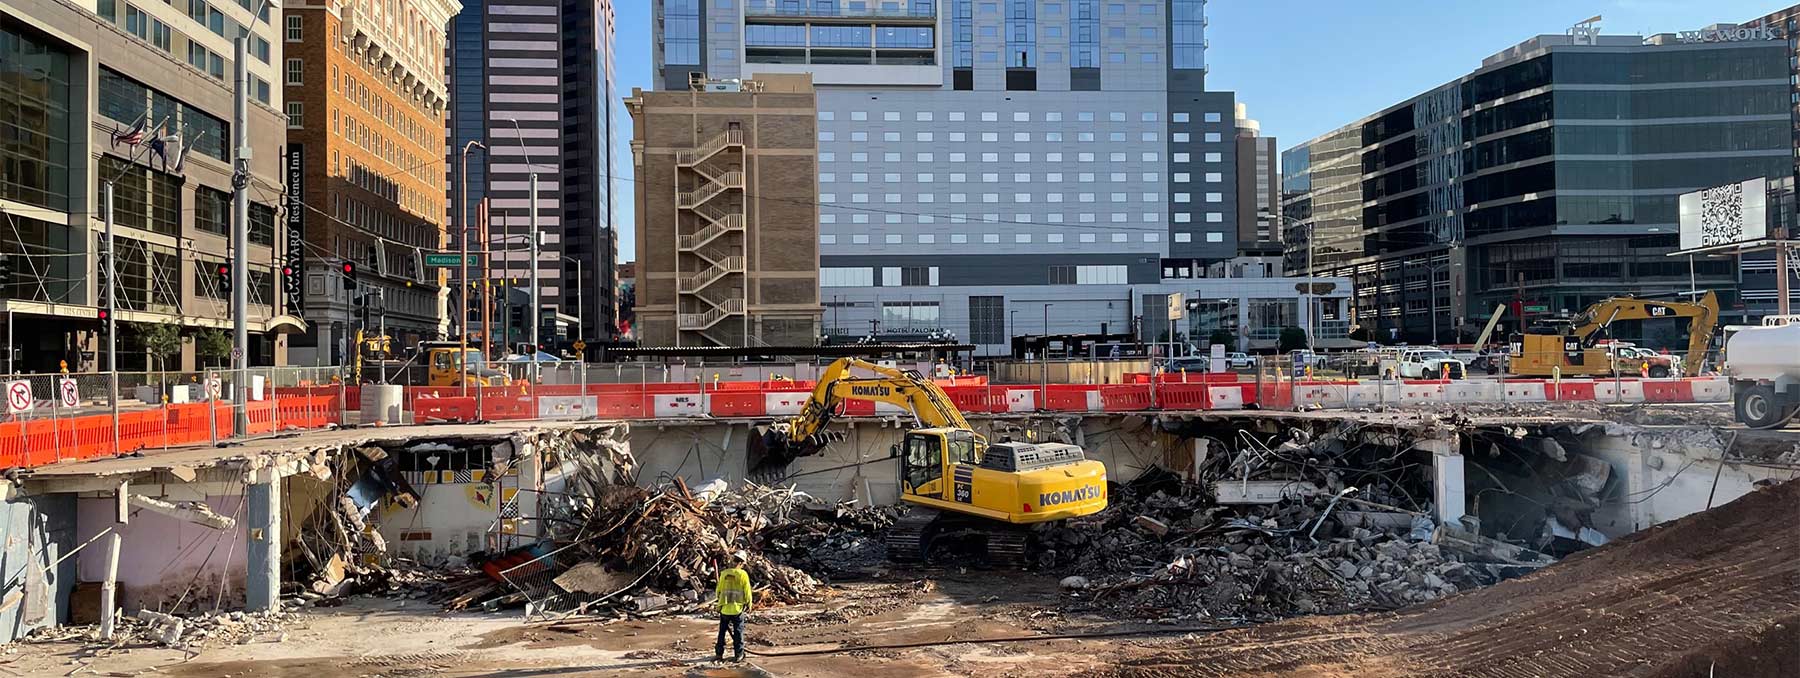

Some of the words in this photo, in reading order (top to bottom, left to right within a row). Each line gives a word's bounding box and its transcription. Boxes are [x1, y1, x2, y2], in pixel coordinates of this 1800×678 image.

[1573, 27, 1601, 45] EY
[1679, 18, 1777, 43] wework
[290, 151, 300, 170] Inn
[291, 171, 300, 223] Residence
[431, 256, 461, 264] Madison
[1652, 306, 1666, 316] CAT
[1565, 342, 1578, 351] CAT
[852, 384, 890, 396] KOMATSU
[956, 489, 970, 498] 360
[1039, 484, 1100, 507] KOMATSU
